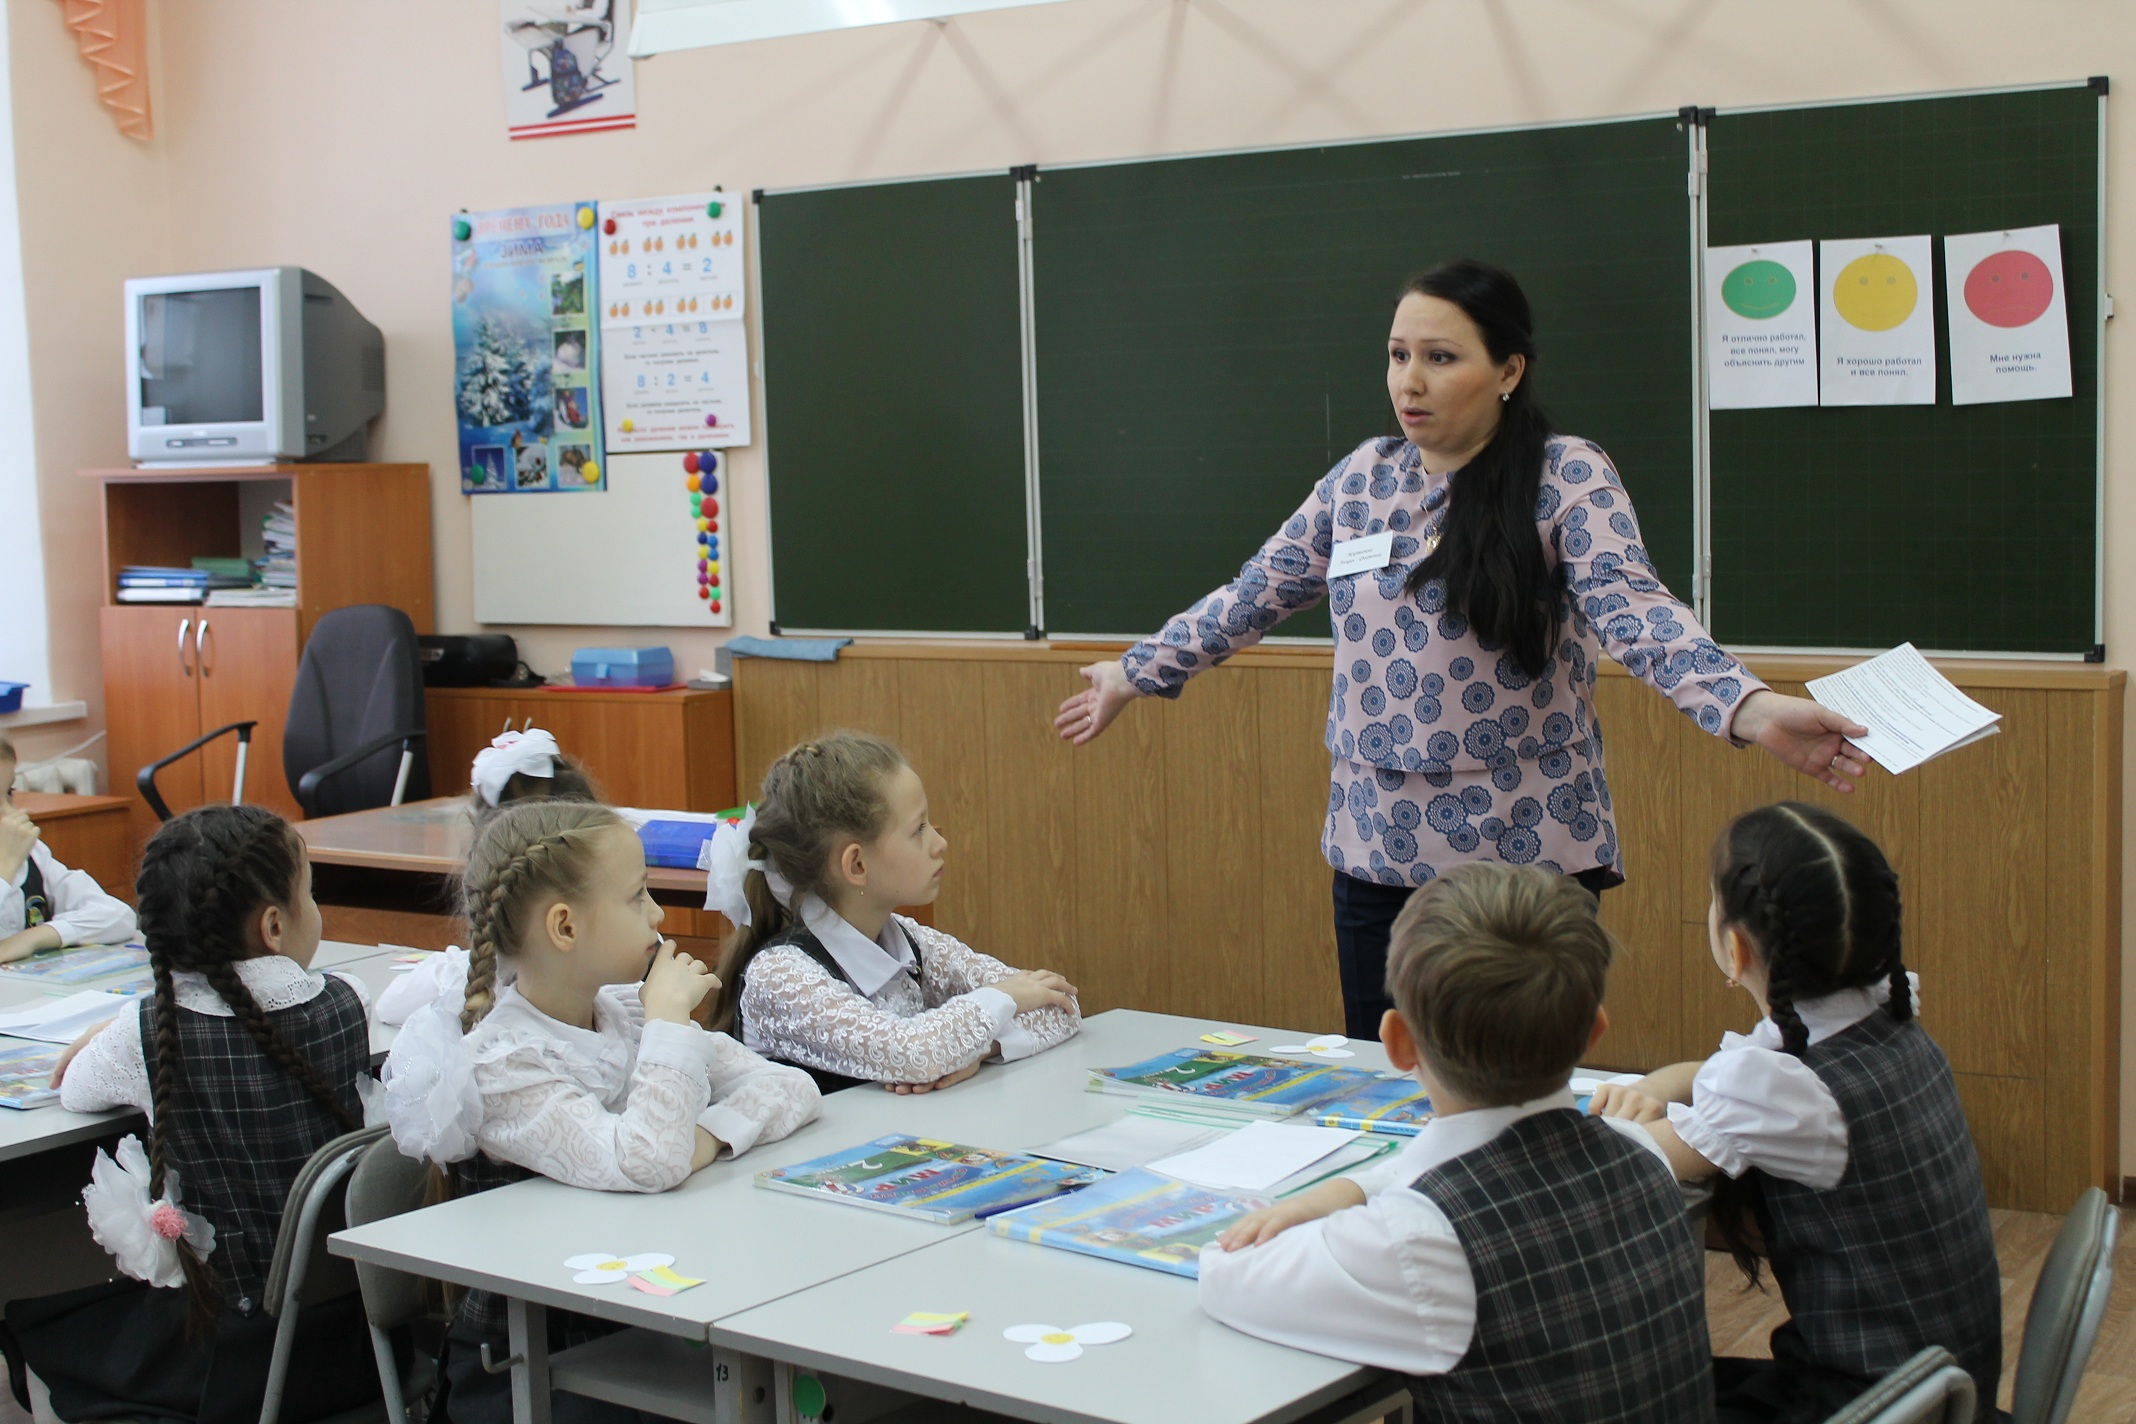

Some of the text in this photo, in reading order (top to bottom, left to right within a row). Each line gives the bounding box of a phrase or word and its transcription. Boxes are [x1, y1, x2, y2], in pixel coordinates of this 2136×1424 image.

[627, 263, 636, 279] 8
[662, 261, 672, 275] 4
[702, 257, 712, 272] 2
[633, 326, 641, 339] 2
[666, 324, 674, 335] 4
[1722, 333, 1806, 343] Я отлично работал,
[1748, 347, 1777, 355] понял,
[1779, 346, 1799, 355] могу
[1724, 358, 1805, 368] объяснить другим
[1837, 356, 1922, 367] Я хорошо работал
[1990, 352, 2042, 363] Мне нужна
[1995, 364, 2037, 374] помощь.
[637, 374, 646, 388] 8
[667, 373, 675, 386] 2
[701, 371, 709, 384] 4
[874, 1168, 942, 1192] МИР
[716, 1363, 729, 1382] 13
